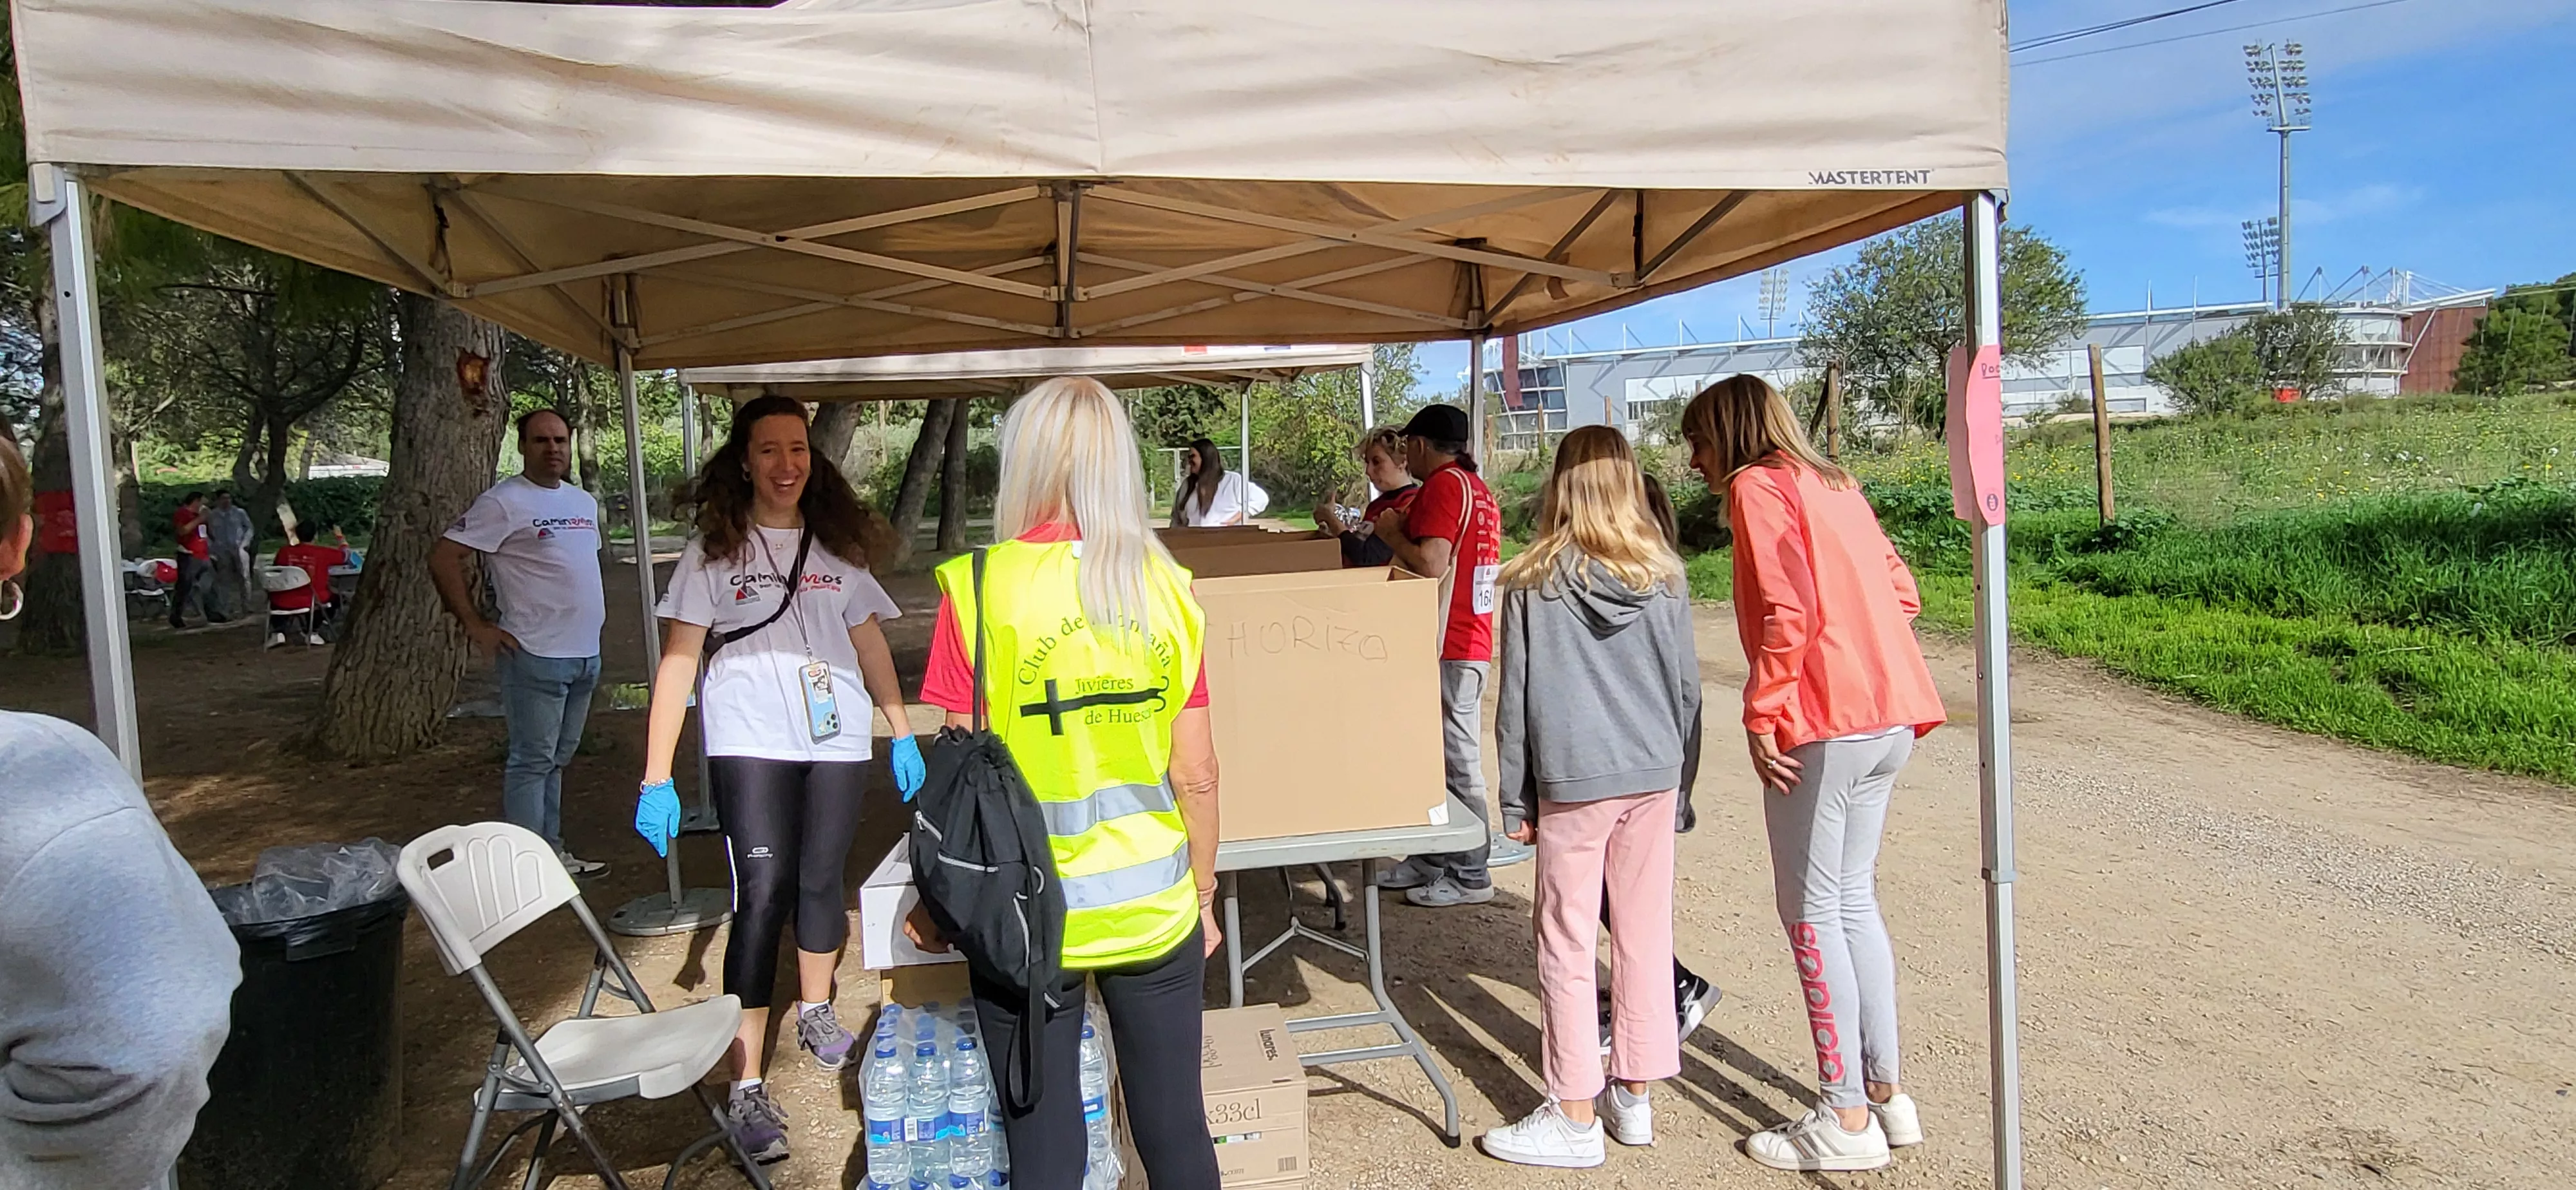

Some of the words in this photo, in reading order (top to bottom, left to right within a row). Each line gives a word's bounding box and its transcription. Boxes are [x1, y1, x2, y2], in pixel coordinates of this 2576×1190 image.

[1808, 170, 1931, 185] MASTERTENT
[1018, 636, 1057, 686] Club
[1061, 616, 1084, 636] de
[1084, 710, 1103, 725] de
